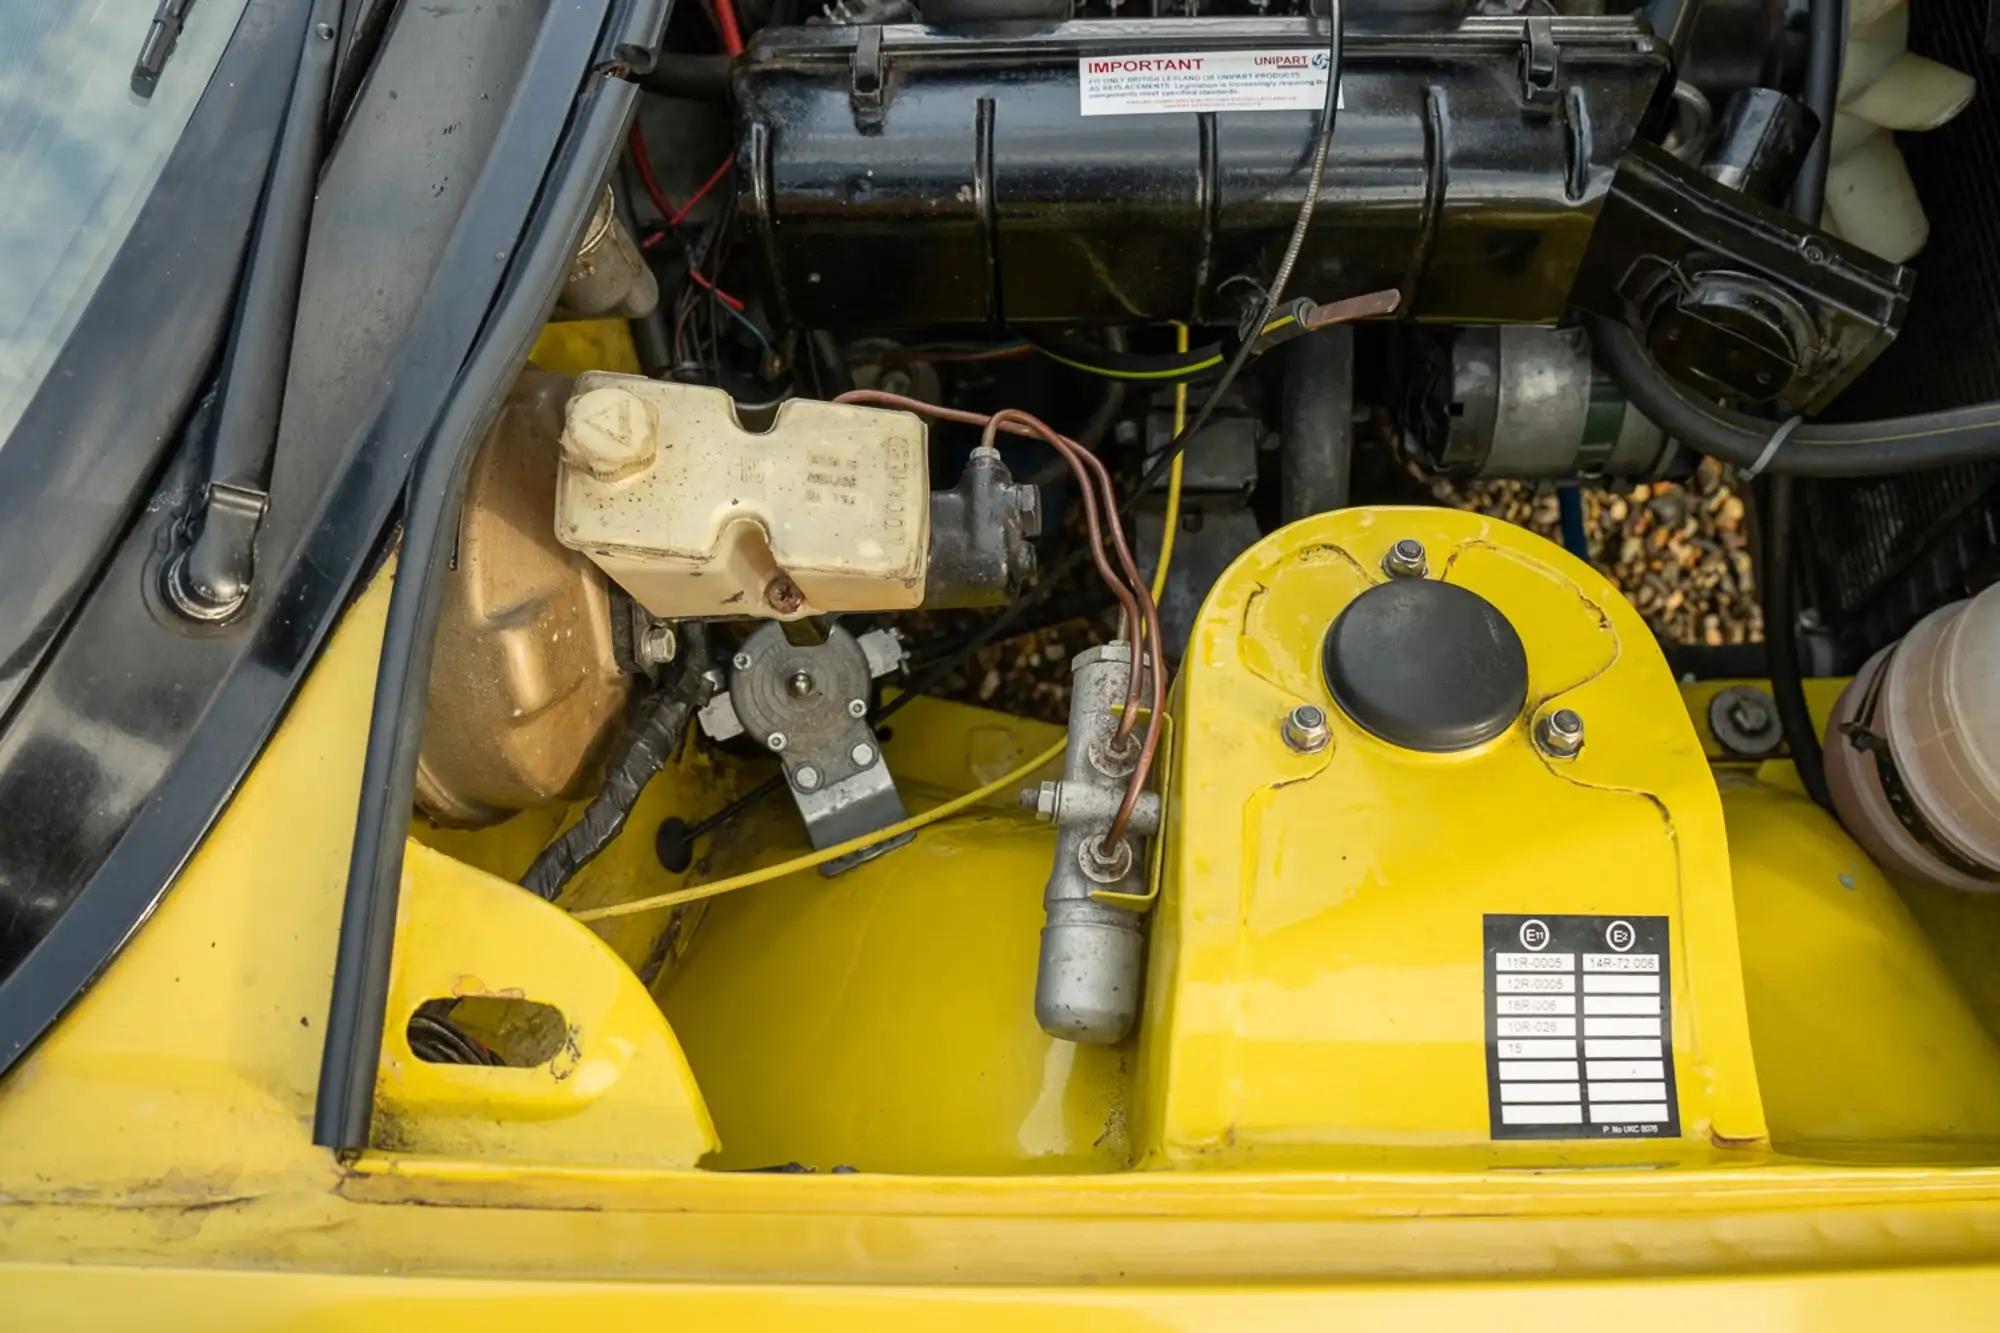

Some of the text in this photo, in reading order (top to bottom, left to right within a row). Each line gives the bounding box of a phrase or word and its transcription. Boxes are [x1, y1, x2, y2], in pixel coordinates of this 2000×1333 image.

[1088, 58, 1204, 74] IMPORTANT
[1254, 55, 1308, 66] UNIPART
[1126, 75, 1160, 83] BRITISH
[1161, 74, 1201, 82] LEYLAND
[1202, 73, 1215, 81] OR
[1216, 72, 1253, 80] UNIPART
[1254, 71, 1301, 79] PRODUCTS
